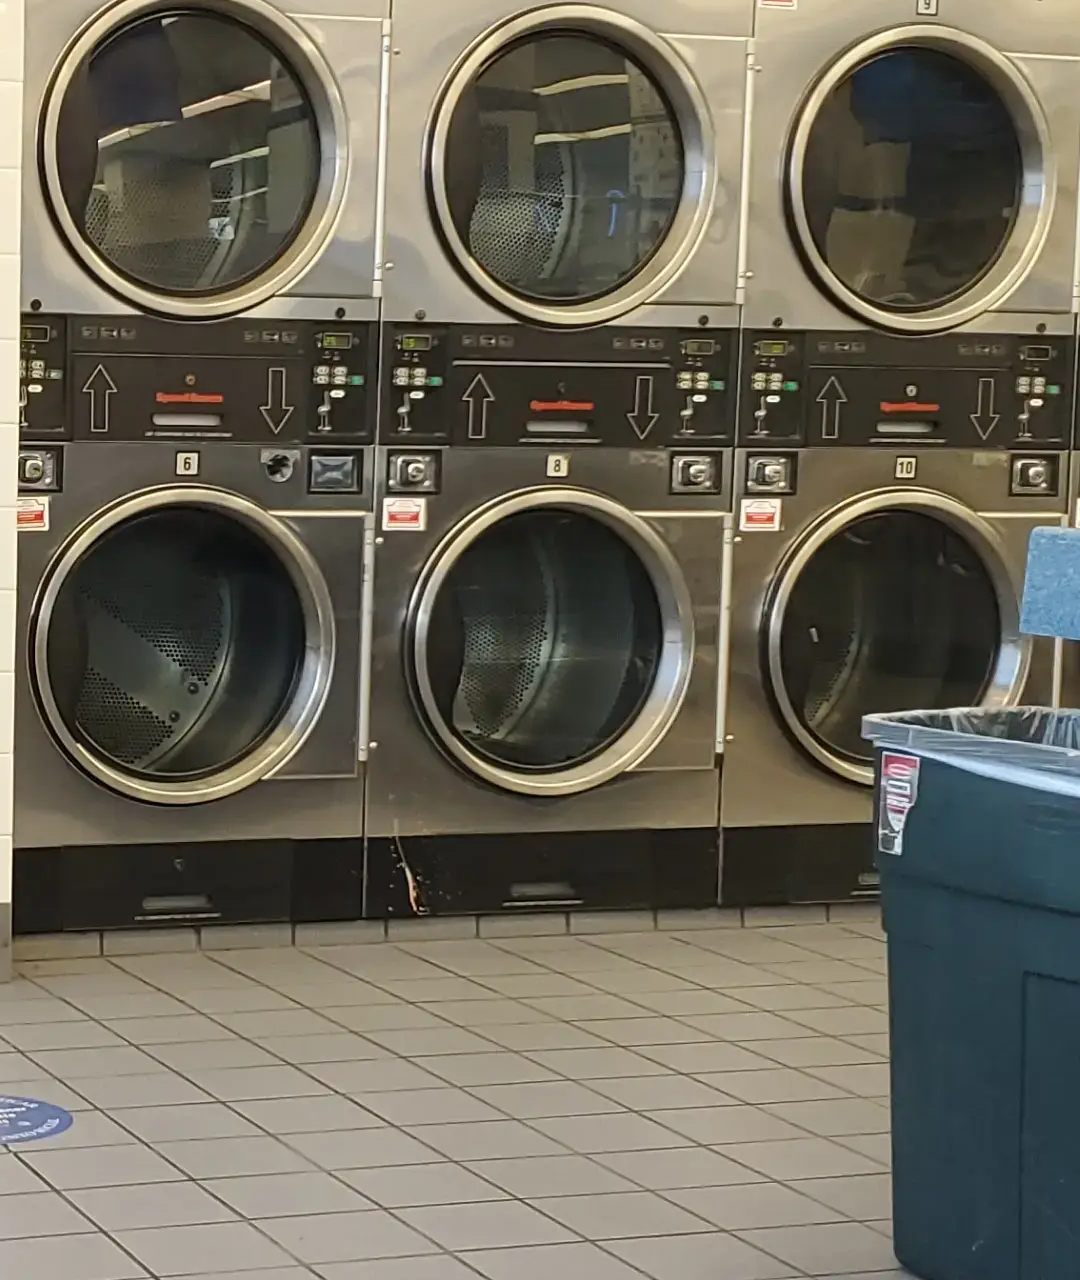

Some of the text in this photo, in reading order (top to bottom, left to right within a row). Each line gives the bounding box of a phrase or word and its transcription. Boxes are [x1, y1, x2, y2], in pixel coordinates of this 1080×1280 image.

[183, 456, 192, 471] 6
[553, 458, 561, 473] 8
[898, 461, 913, 474] 10
